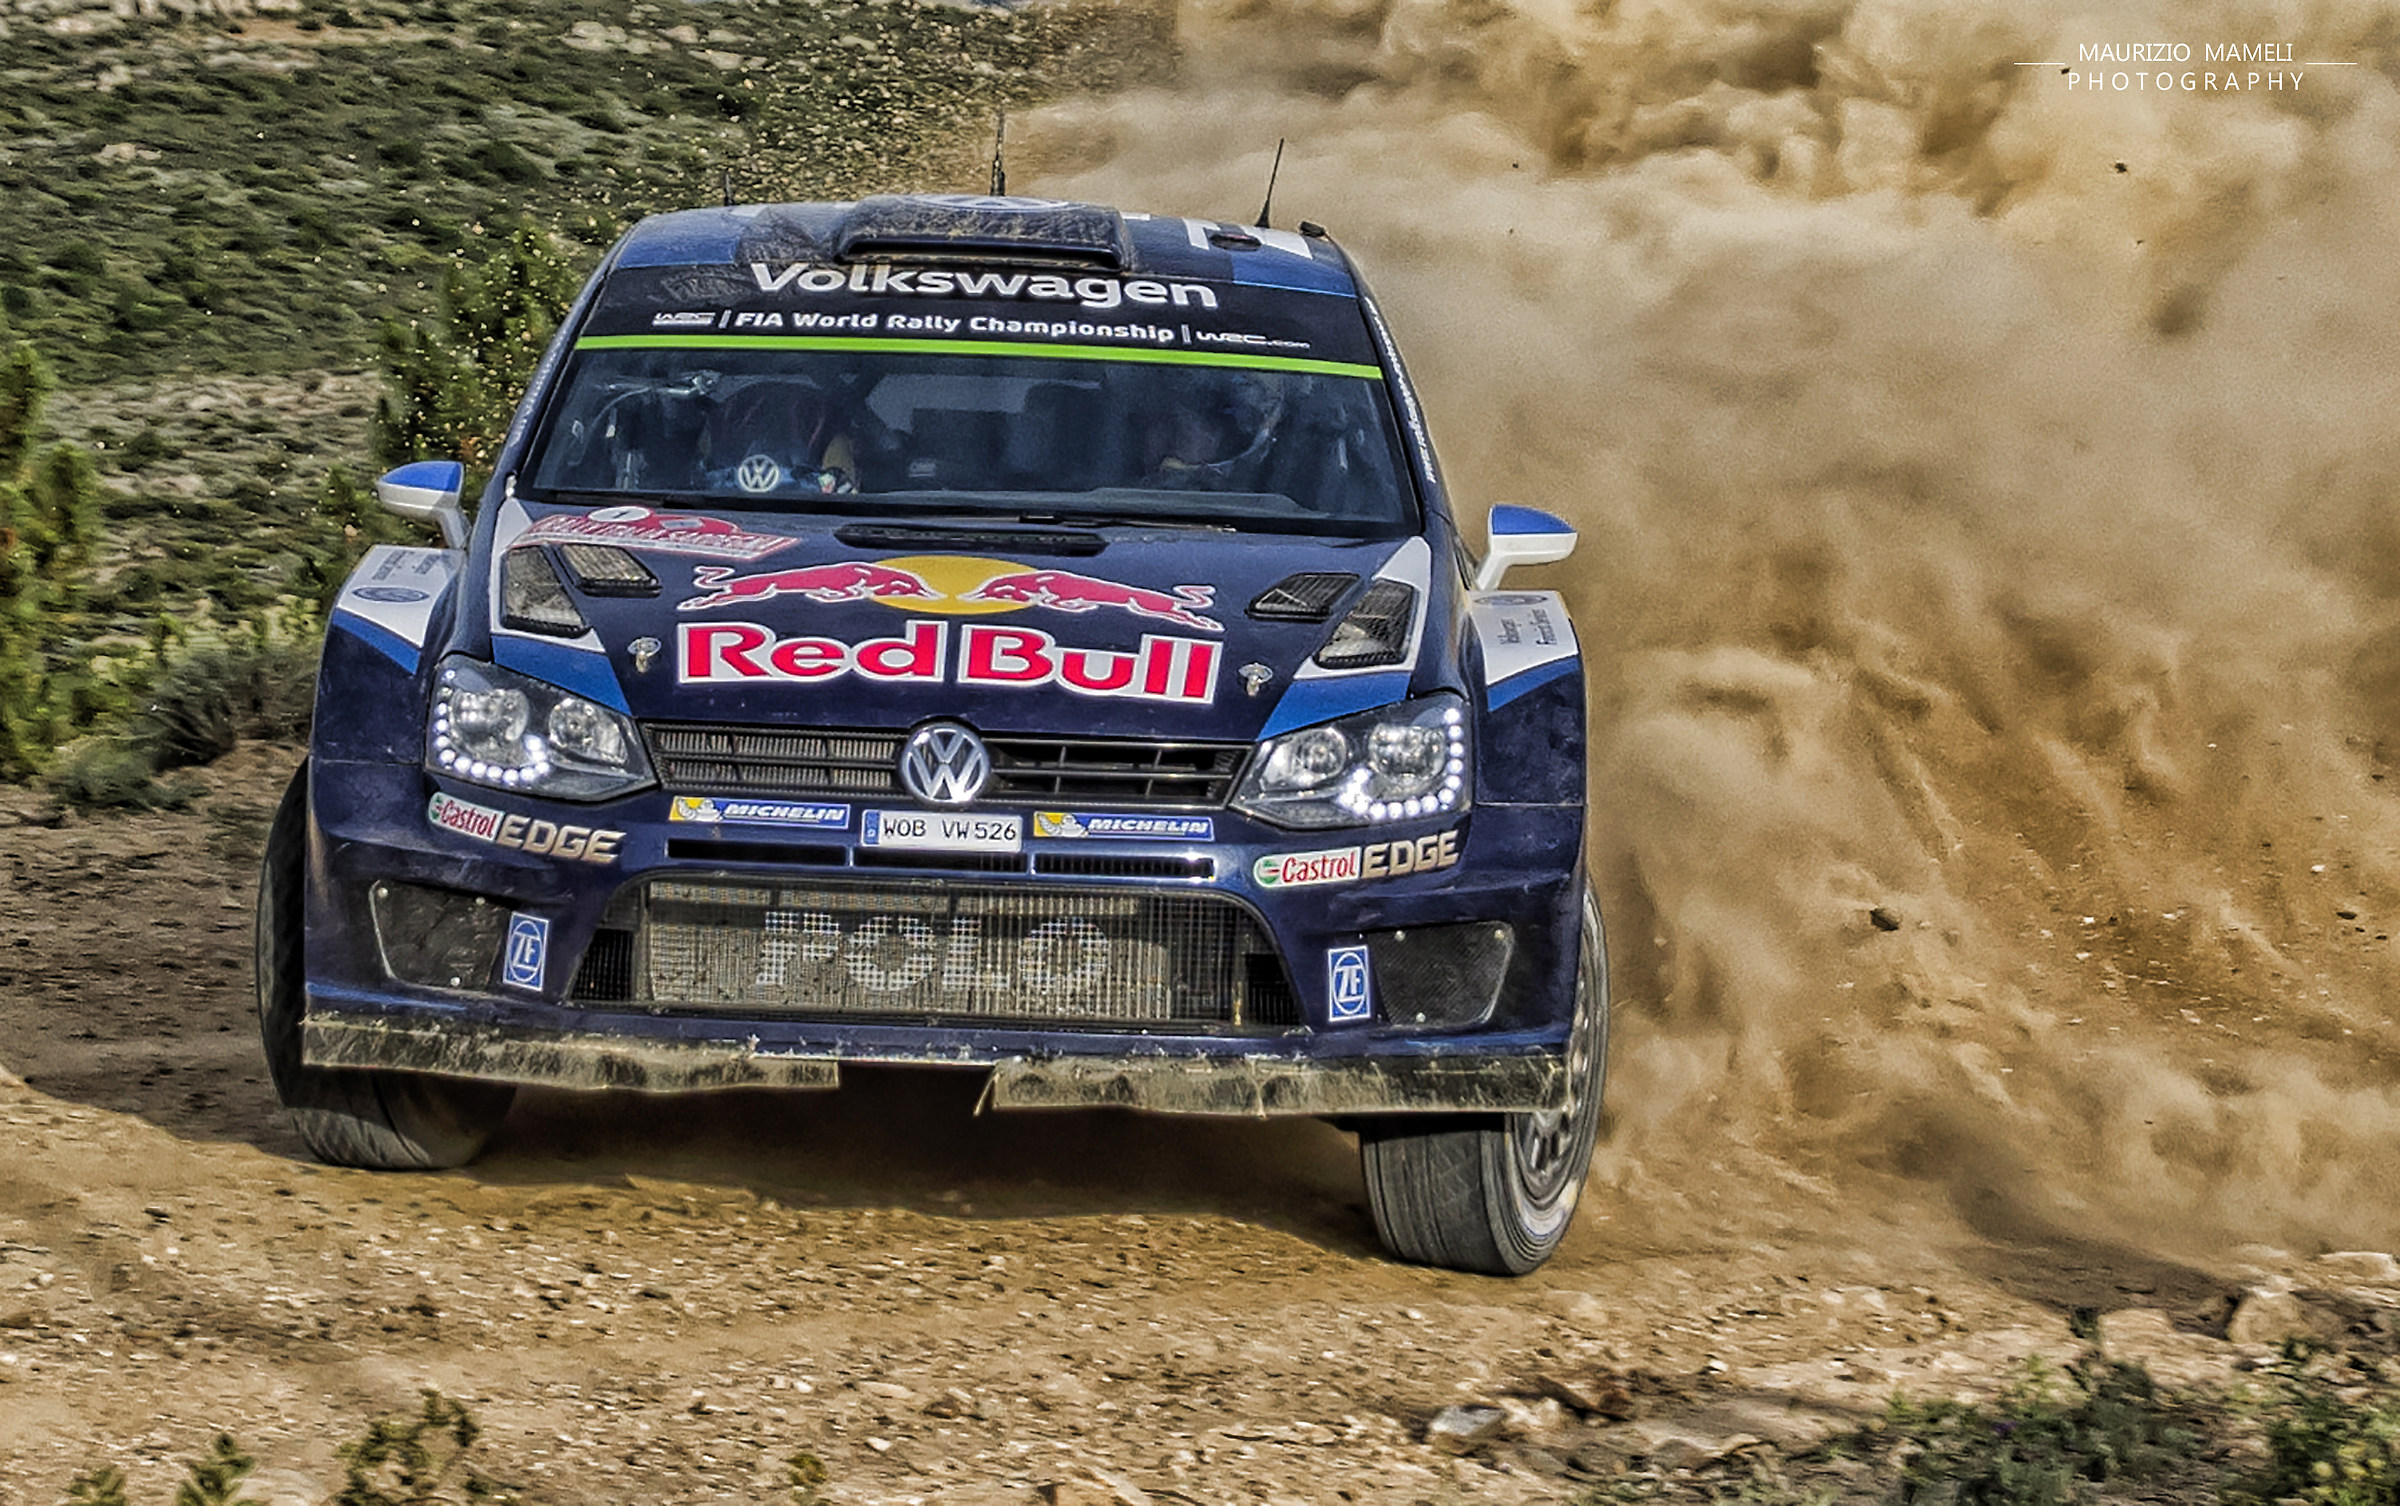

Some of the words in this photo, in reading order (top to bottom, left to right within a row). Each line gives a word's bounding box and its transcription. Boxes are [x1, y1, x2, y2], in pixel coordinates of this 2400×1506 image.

[750, 262, 1218, 309] Volkswagen
[735, 312, 784, 327] FIA
[792, 312, 878, 328] World
[886, 314, 961, 333] Rally
[969, 316, 1175, 343] Championship
[681, 621, 945, 681] Red
[962, 624, 1220, 702] Bull
[439, 799, 499, 838] Castrol
[496, 813, 628, 864] EDGE
[724, 803, 845, 821] MICHELIN
[883, 817, 926, 838] WOB
[1087, 818, 1209, 834] MICHELIN
[1281, 852, 1356, 883] Castrol
[1360, 829, 1460, 879] EDGE
[756, 910, 1110, 992] POLO
